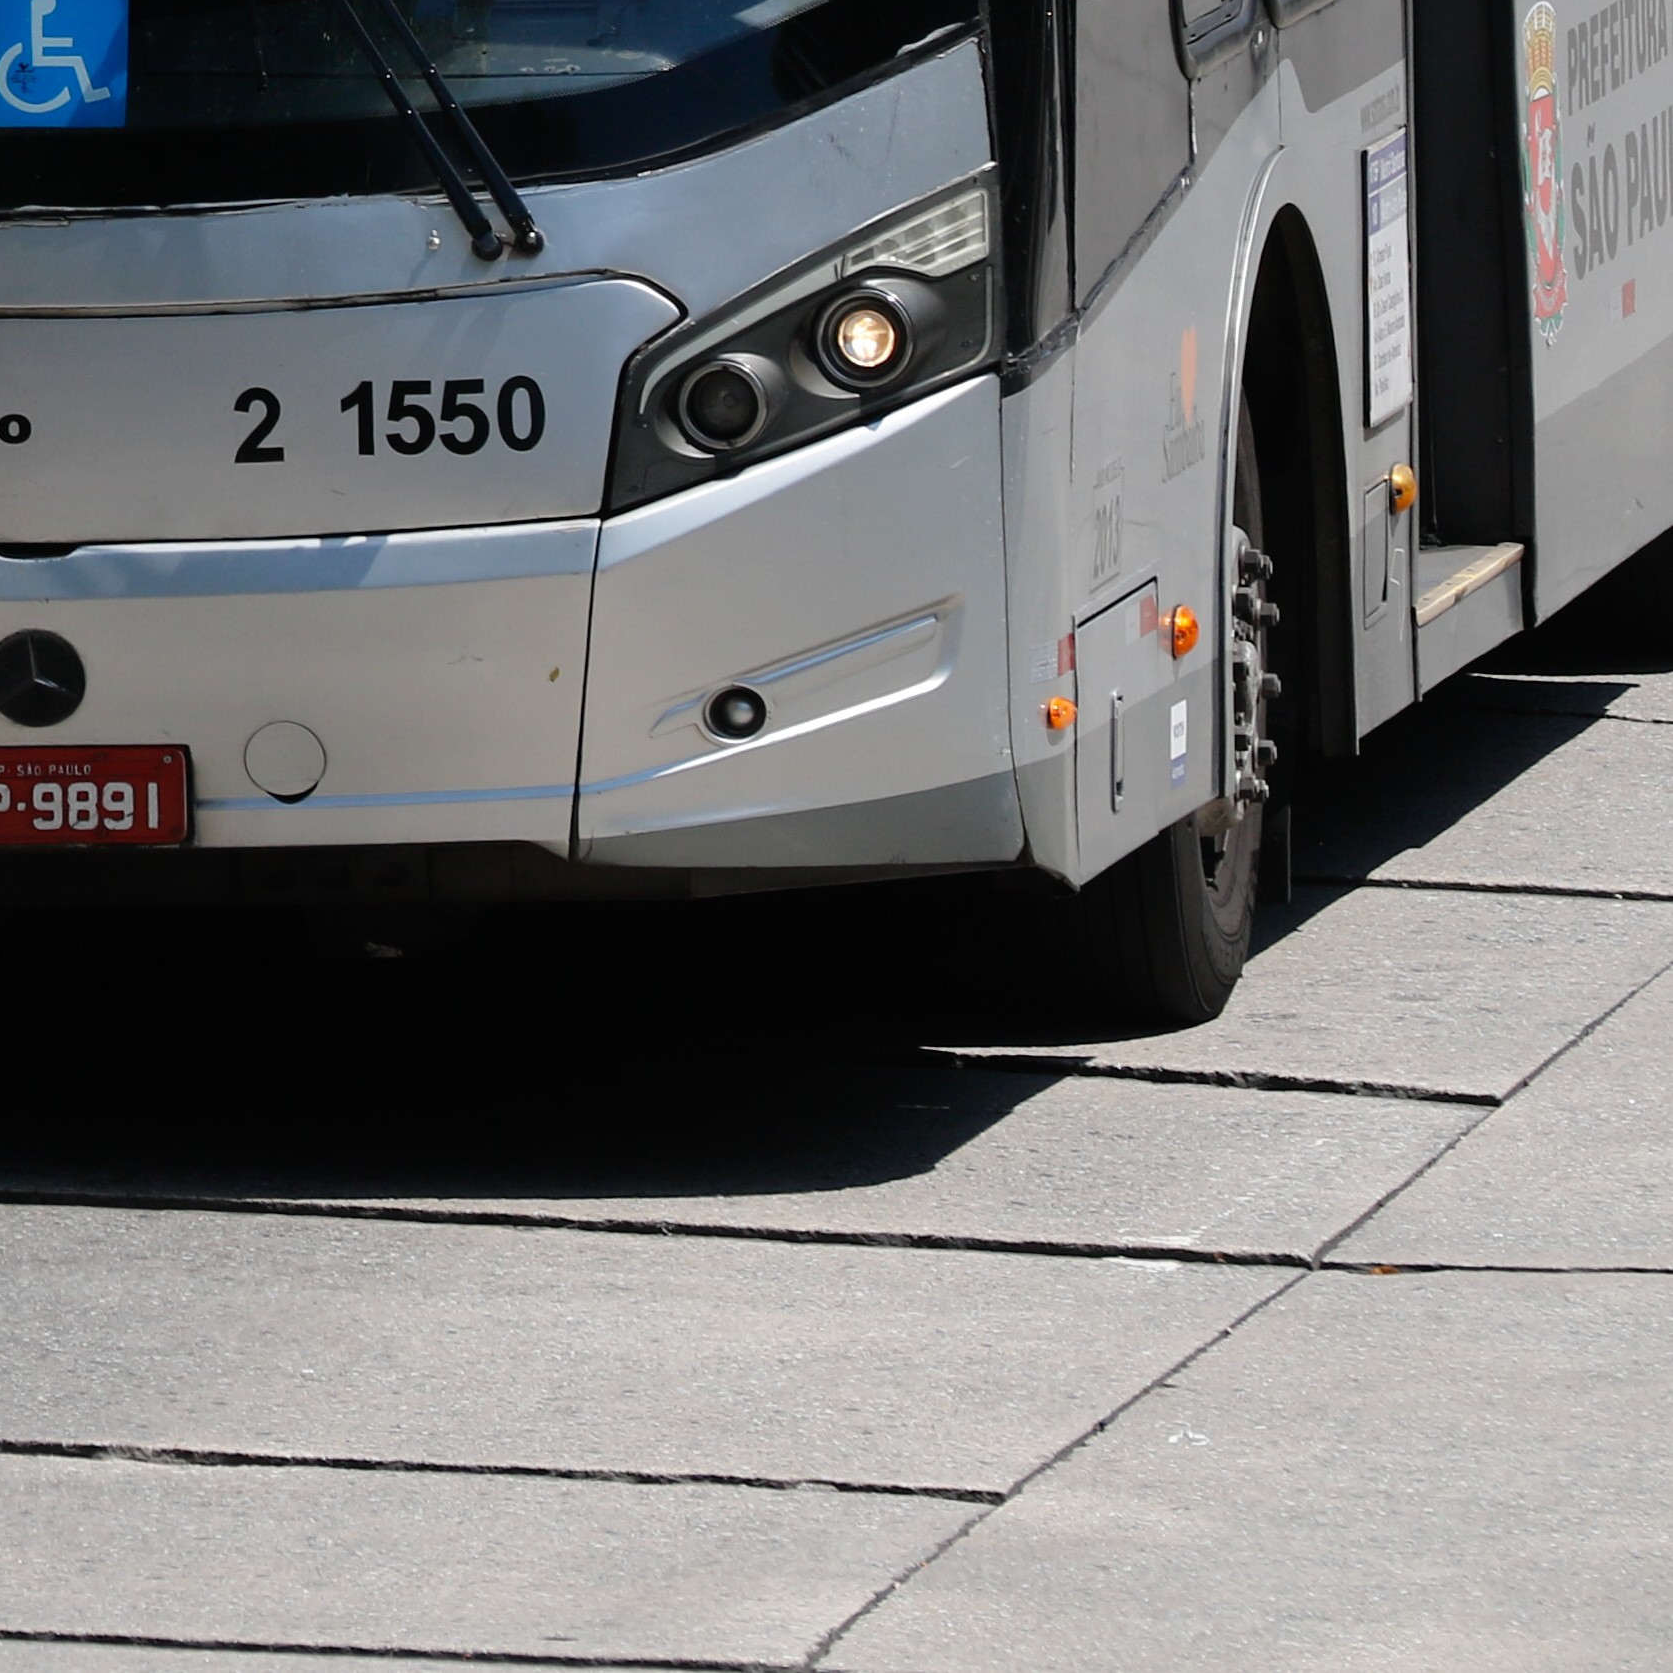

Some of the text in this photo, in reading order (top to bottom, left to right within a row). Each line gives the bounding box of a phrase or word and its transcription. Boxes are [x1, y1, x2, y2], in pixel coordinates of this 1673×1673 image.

[1571, 123, 1619, 281] SÃO
[234, 375, 546, 465] 2 1550
[1094, 494, 1120, 580] 2013
[17, 762, 41, 777] SÃO
[49, 764, 91, 776] PAULO
